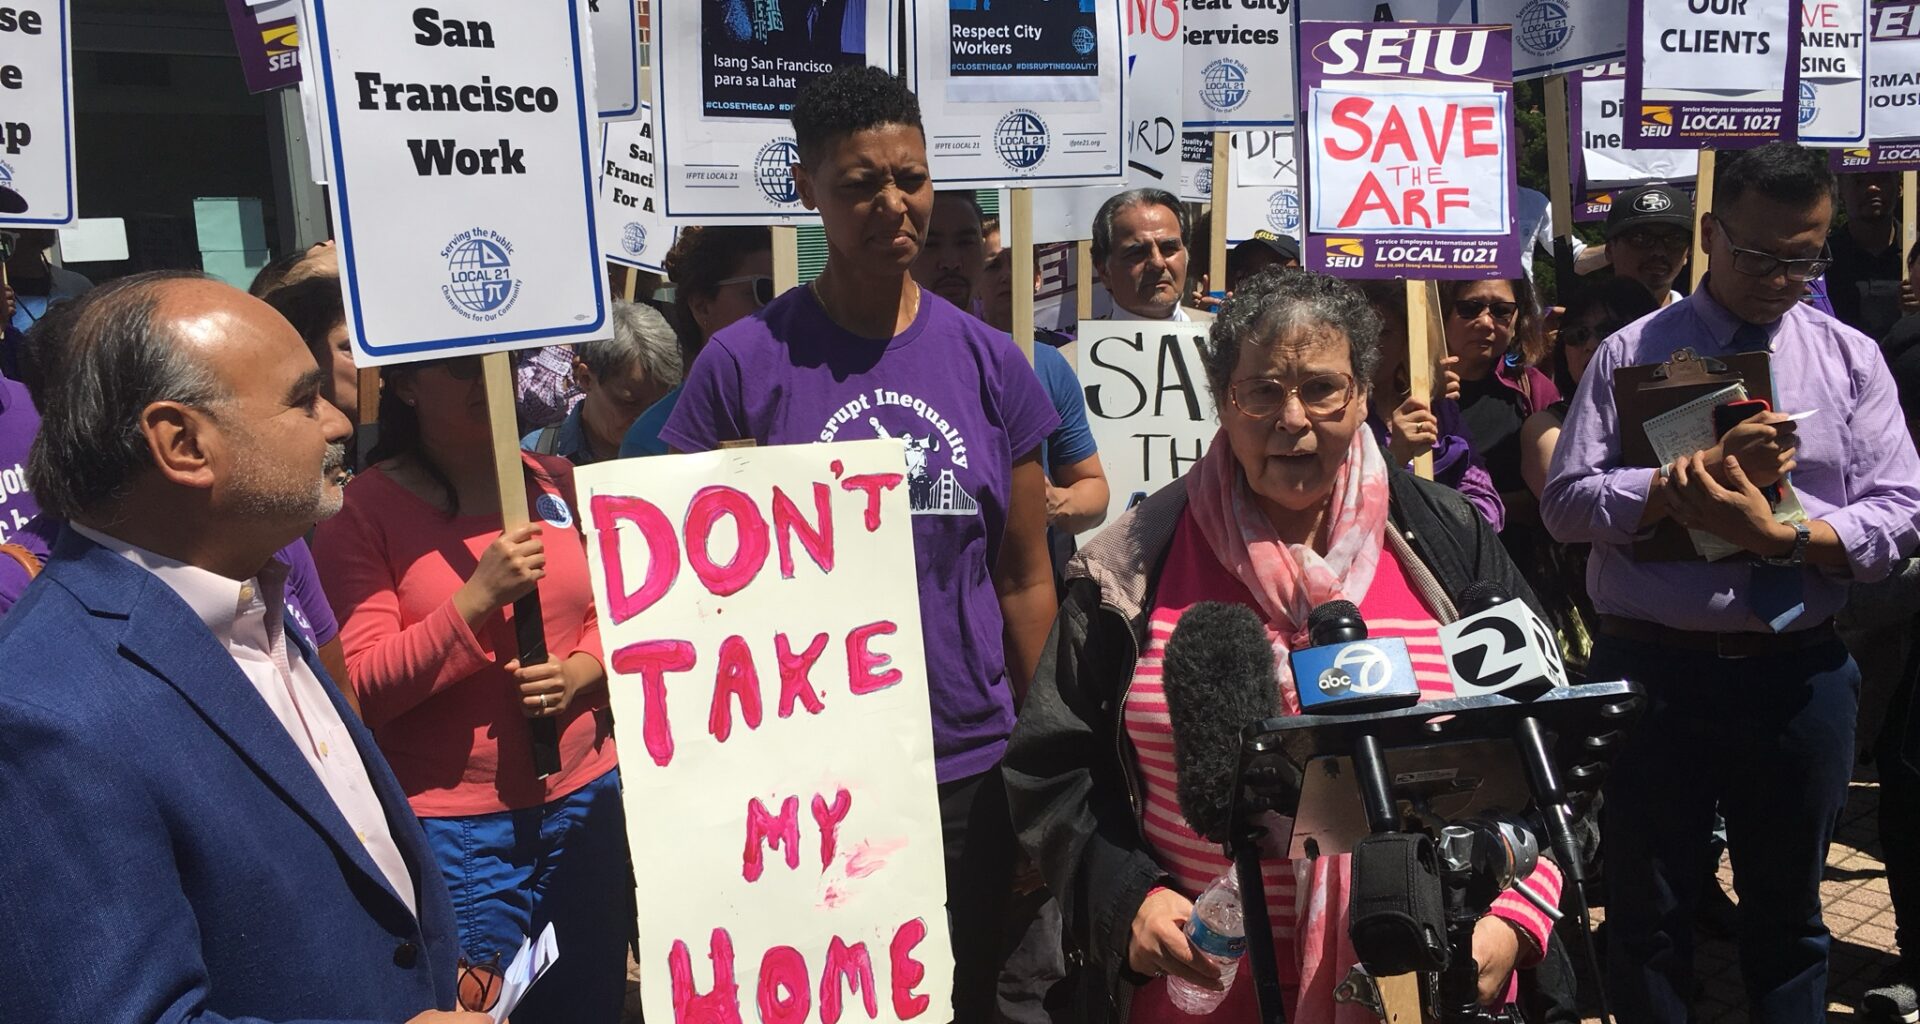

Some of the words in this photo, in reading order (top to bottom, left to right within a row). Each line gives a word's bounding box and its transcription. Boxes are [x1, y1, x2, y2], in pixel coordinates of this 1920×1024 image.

[1688, 0, 1746, 15] OUR
[412, 7, 495, 48] San
[952, 24, 1010, 40] Respect
[1014, 25, 1042, 40] City
[1523, 22, 1552, 34] LOCAL
[1555, 20, 1566, 28] 21
[952, 41, 1012, 54] Workers
[1660, 28, 1770, 54] CLIENTS
[268, 50, 300, 72] SEI
[1322, 28, 1489, 75] SEIU
[714, 54, 748, 72] Isang
[751, 56, 774, 70] San
[776, 58, 833, 73] Francisco
[1016, 62, 1098, 70] #DISRUPTINEQUALITY
[1200, 59, 1222, 76] Serving
[1802, 57, 1846, 73] SING
[714, 74, 743, 88] para
[746, 77, 758, 87] sa
[762, 75, 796, 88] Lahat
[354, 71, 559, 113] Francisco
[706, 102, 775, 111] #CLOSETHEGAP
[1324, 96, 1498, 165] SAVE
[1640, 126, 1672, 137] SEIU
[1681, 116, 1738, 130] LOCAL
[1744, 116, 1781, 130] 1021
[0, 121, 32, 155] p
[1000, 136, 1030, 146] LOCAL
[1032, 136, 1044, 144] 21
[1586, 131, 1620, 148] Ine
[406, 138, 526, 176] Work
[606, 160, 654, 188] Franci
[686, 172, 705, 180] IFPTE
[706, 172, 728, 180] LOCAL
[730, 172, 738, 180] 21
[1386, 166, 1448, 186] THE
[613, 187, 638, 208] For
[1336, 170, 1470, 229] ARF
[1586, 204, 1612, 214] SEIU
[440, 231, 471, 259] Serving
[472, 227, 488, 237] the
[490, 230, 514, 256] Public
[1326, 256, 1364, 268] SEIU
[1375, 247, 1445, 262] LOCAL
[1452, 248, 1498, 262] 1021
[451, 270, 492, 283] LOCAL
[494, 268, 510, 280] 21
[441, 284, 471, 320] Champions
[472, 313, 482, 322] for
[484, 313, 497, 322] Our
[498, 278, 523, 316] Community
[874, 388, 968, 469] Inequality
[590, 458, 903, 626] DON'T
[1452, 617, 1526, 686] 2
[1335, 646, 1388, 693] 7
[1318, 674, 1351, 689] abc
[611, 620, 902, 767] TAKE
[742, 787, 852, 883] MY
[668, 916, 930, 1024] HOME
